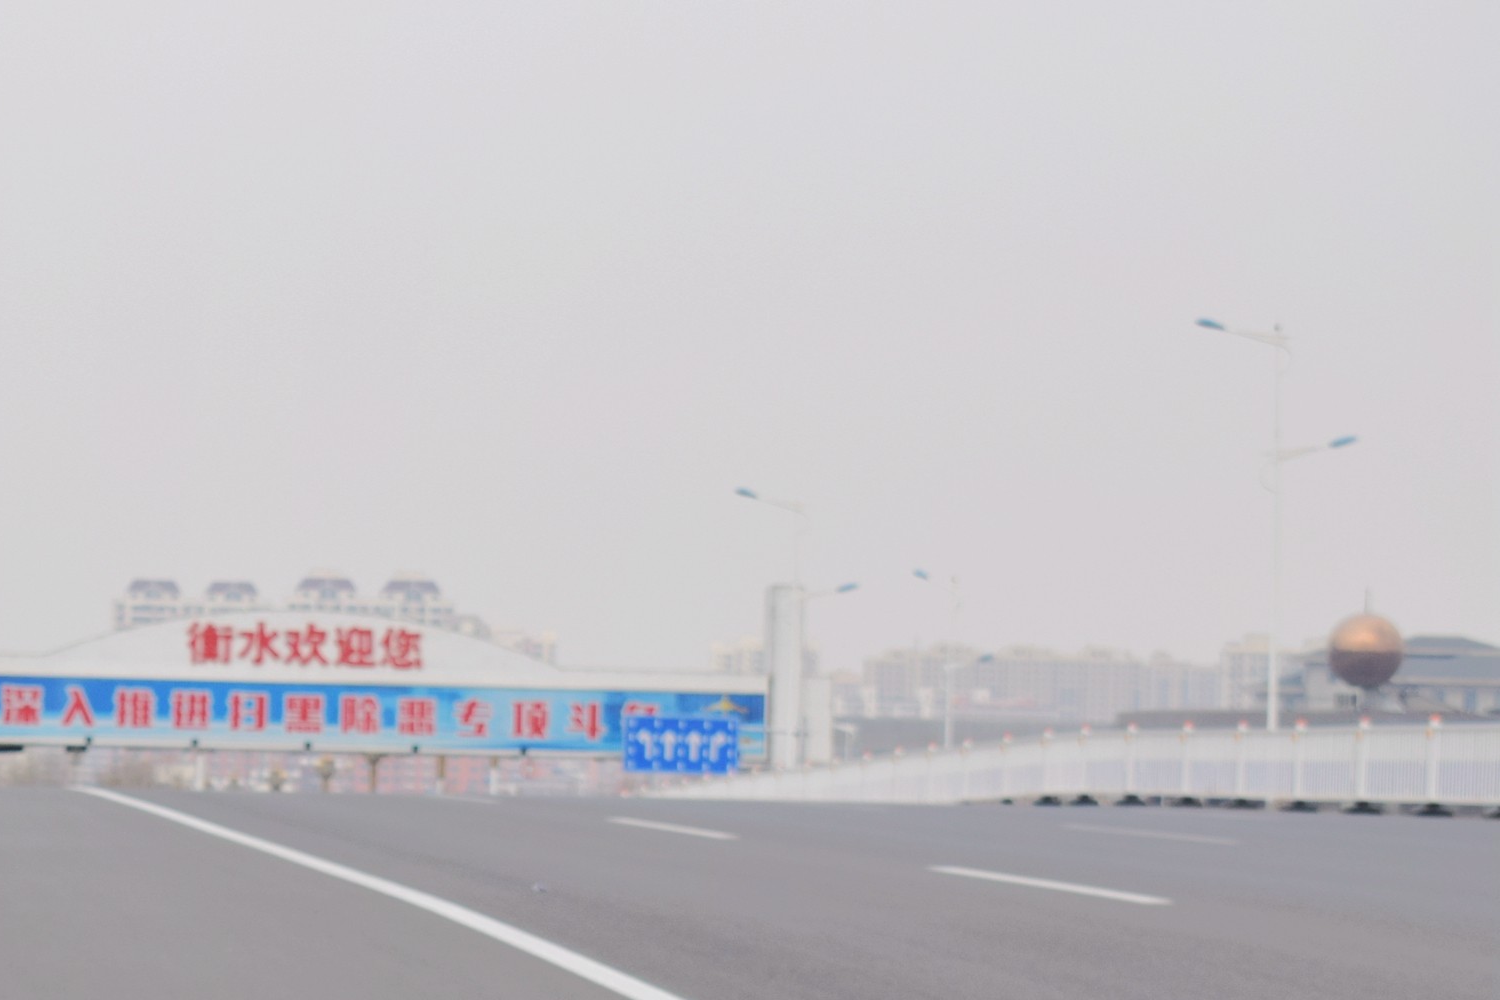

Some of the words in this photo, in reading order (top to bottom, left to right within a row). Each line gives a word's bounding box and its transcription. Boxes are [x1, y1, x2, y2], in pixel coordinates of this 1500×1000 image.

[186, 621, 423, 670] 衡水欢迎您
[1, 683, 659, 741] 深入推进扫黑除恶专项斗
